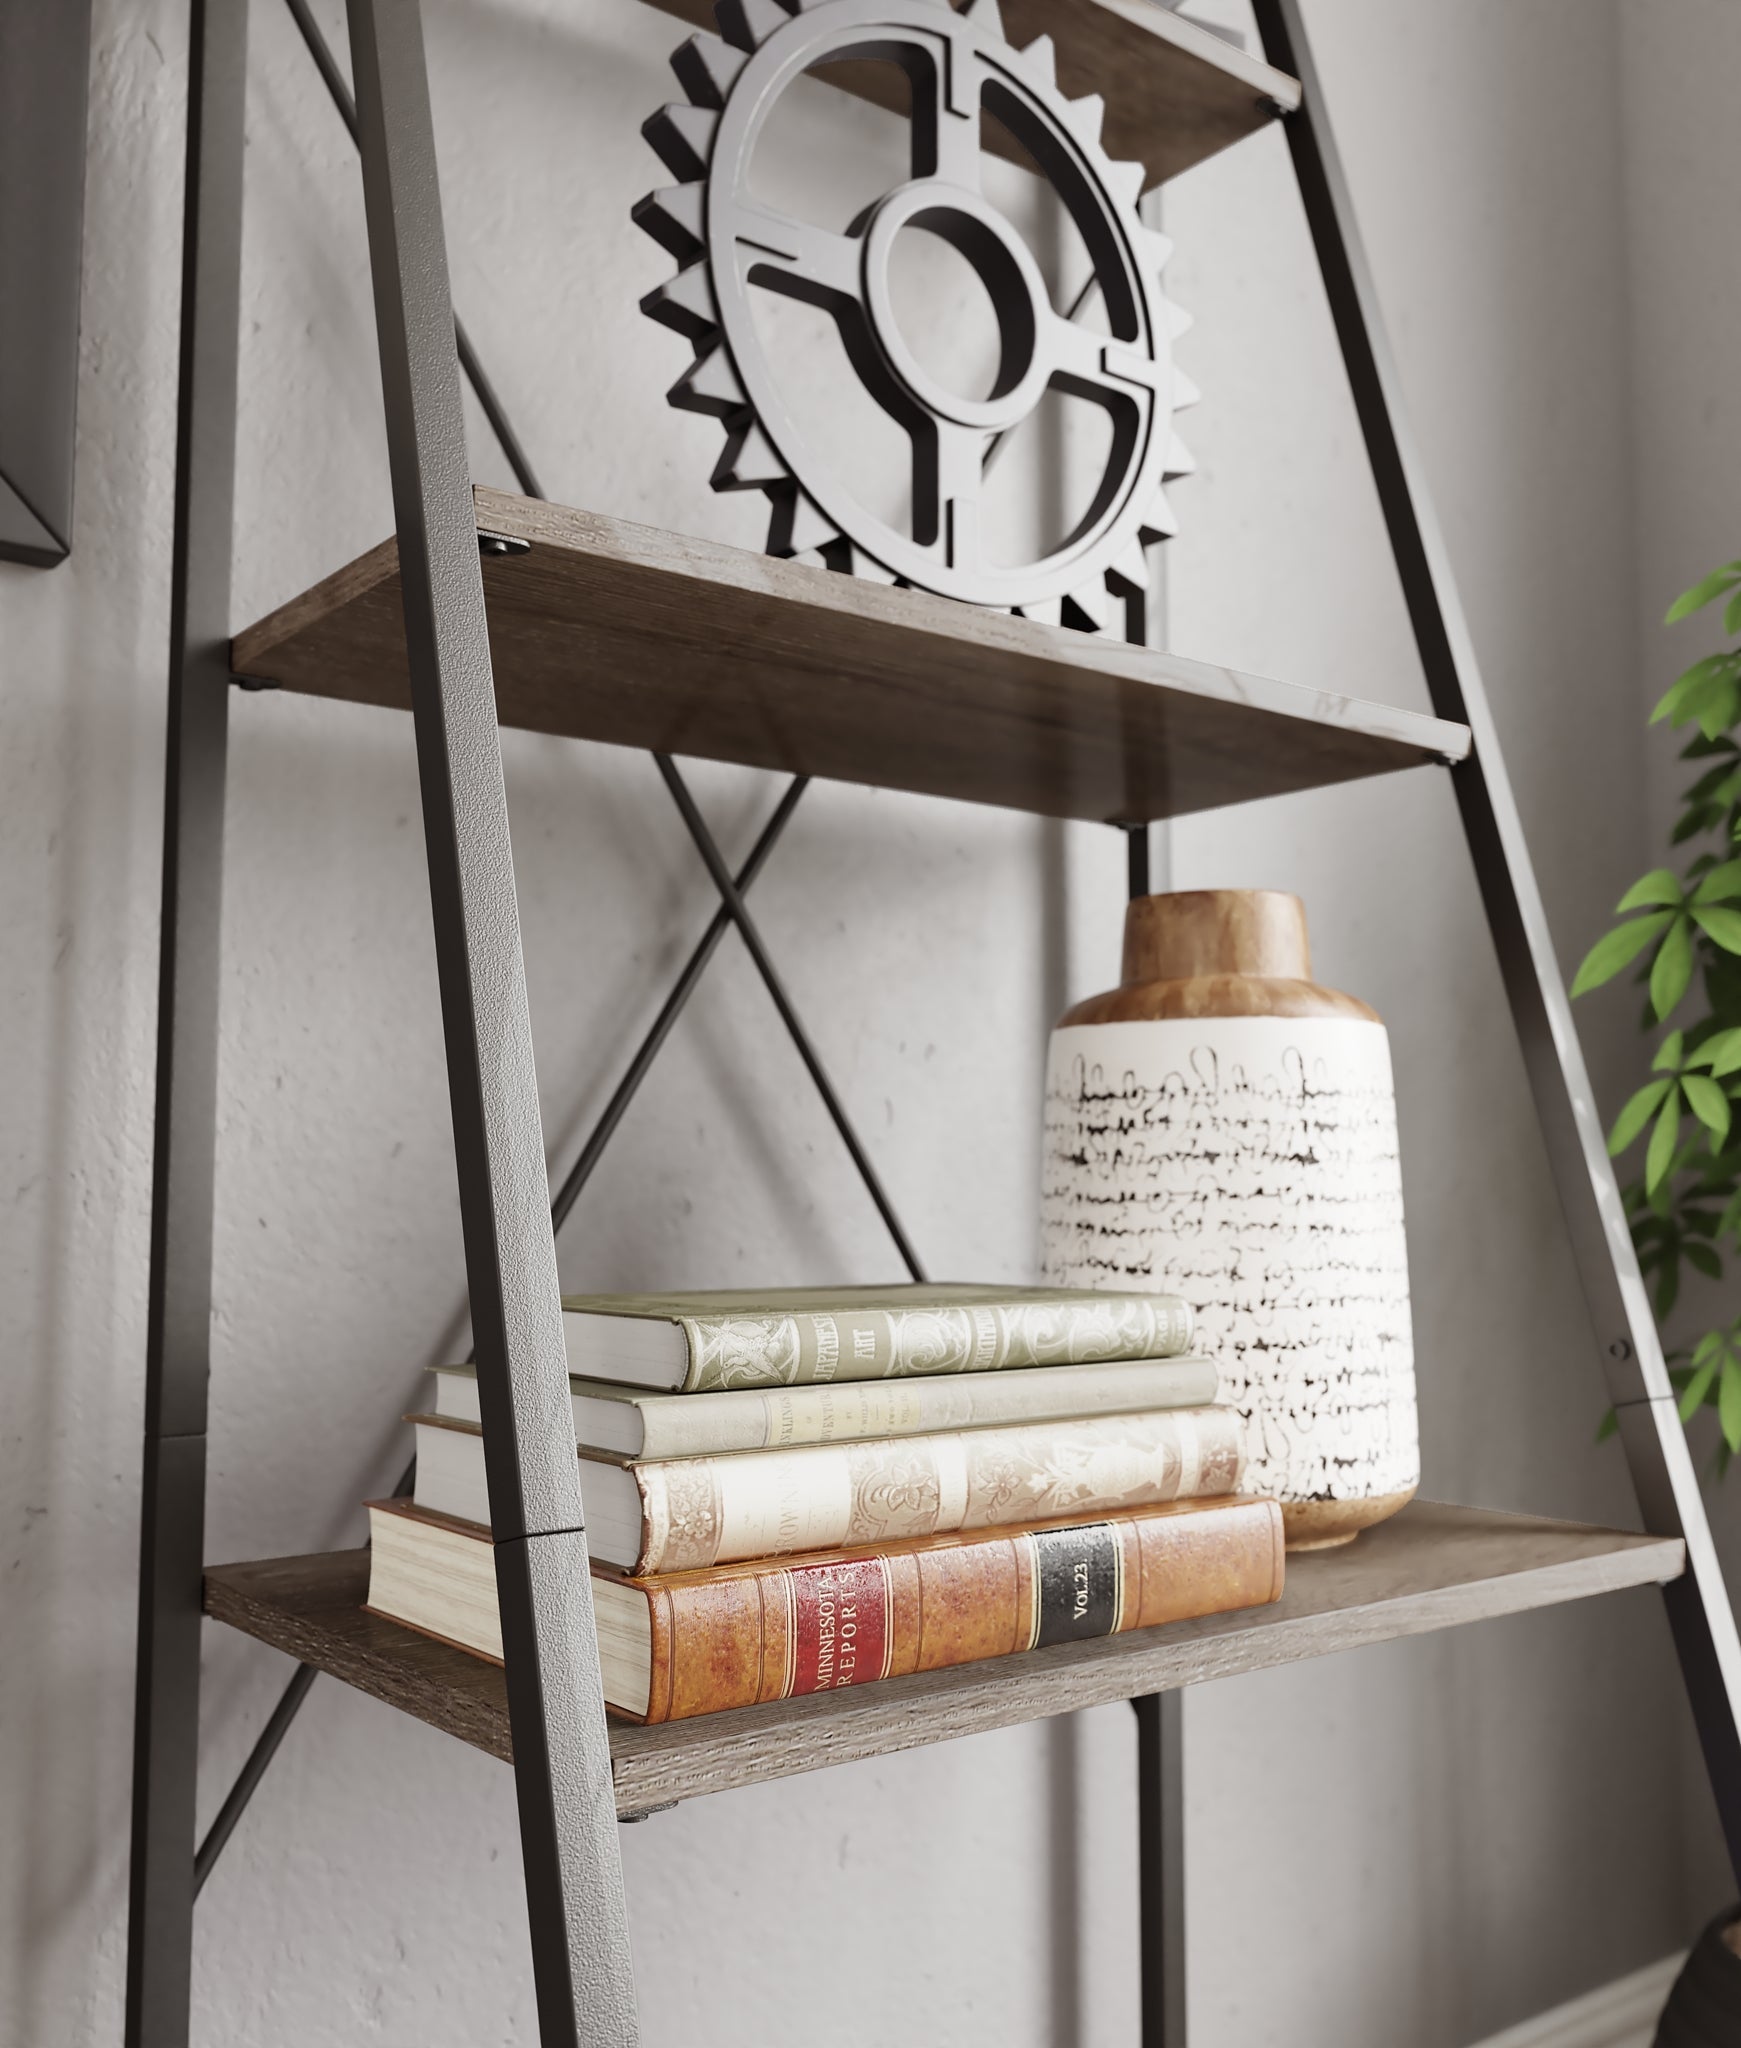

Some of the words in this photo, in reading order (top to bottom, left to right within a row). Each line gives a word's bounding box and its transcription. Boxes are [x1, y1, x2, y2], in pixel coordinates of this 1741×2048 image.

[811, 1314, 839, 1380] JAPANESE
[853, 1329, 875, 1359] ART
[814, 1575, 835, 1691] MINNESOTA
[836, 1572, 857, 1687] REPORTS
